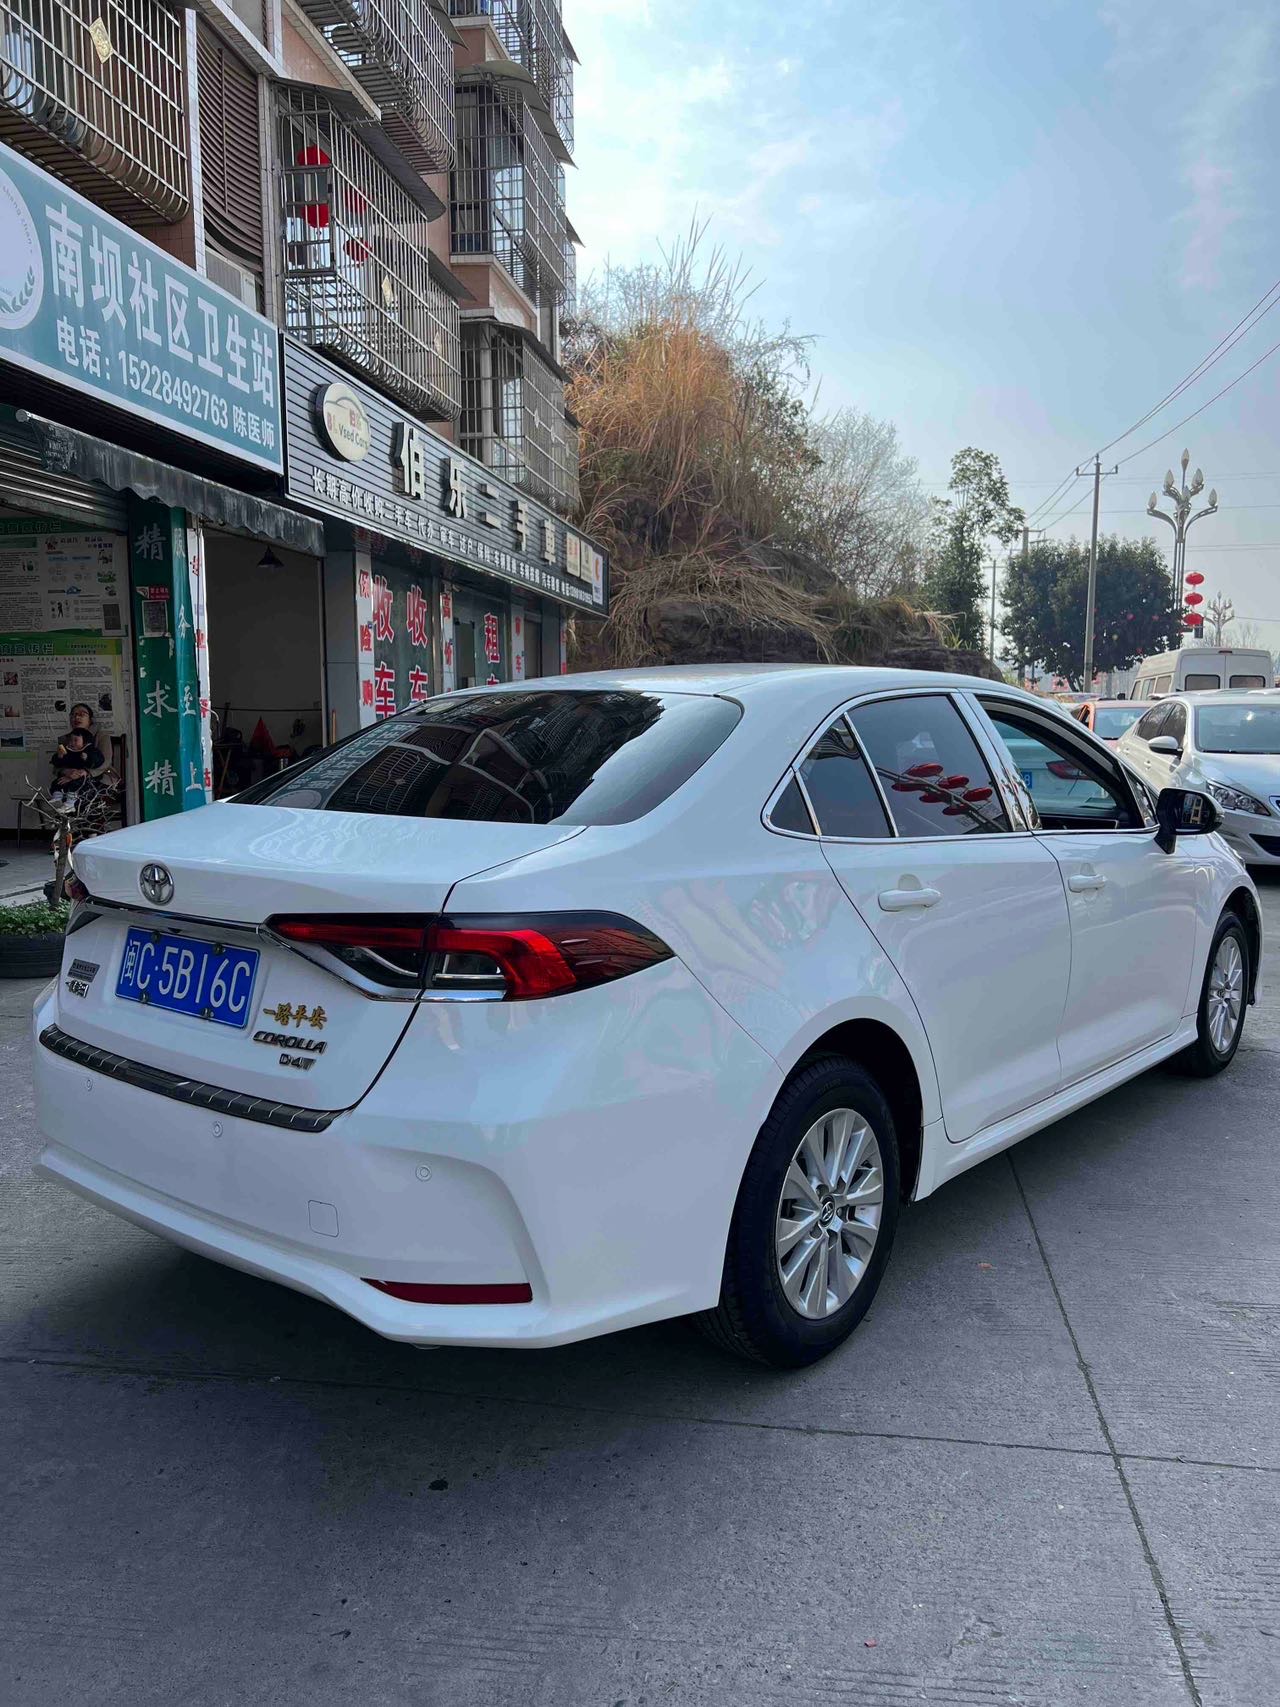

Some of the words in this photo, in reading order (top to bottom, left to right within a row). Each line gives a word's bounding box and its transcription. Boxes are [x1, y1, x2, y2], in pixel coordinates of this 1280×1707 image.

[45, 203, 274, 409] 南坝社区卫生站
[233, 405, 275, 450] 陈医师
[312, 466, 412, 530] 长期高价收购二手车
[400, 421, 557, 566] 伯乐二手车
[134, 523, 178, 797] 精求精
[253, 1030, 327, 1054] COROLLA
[262, 1002, 328, 1030] 一路平安
